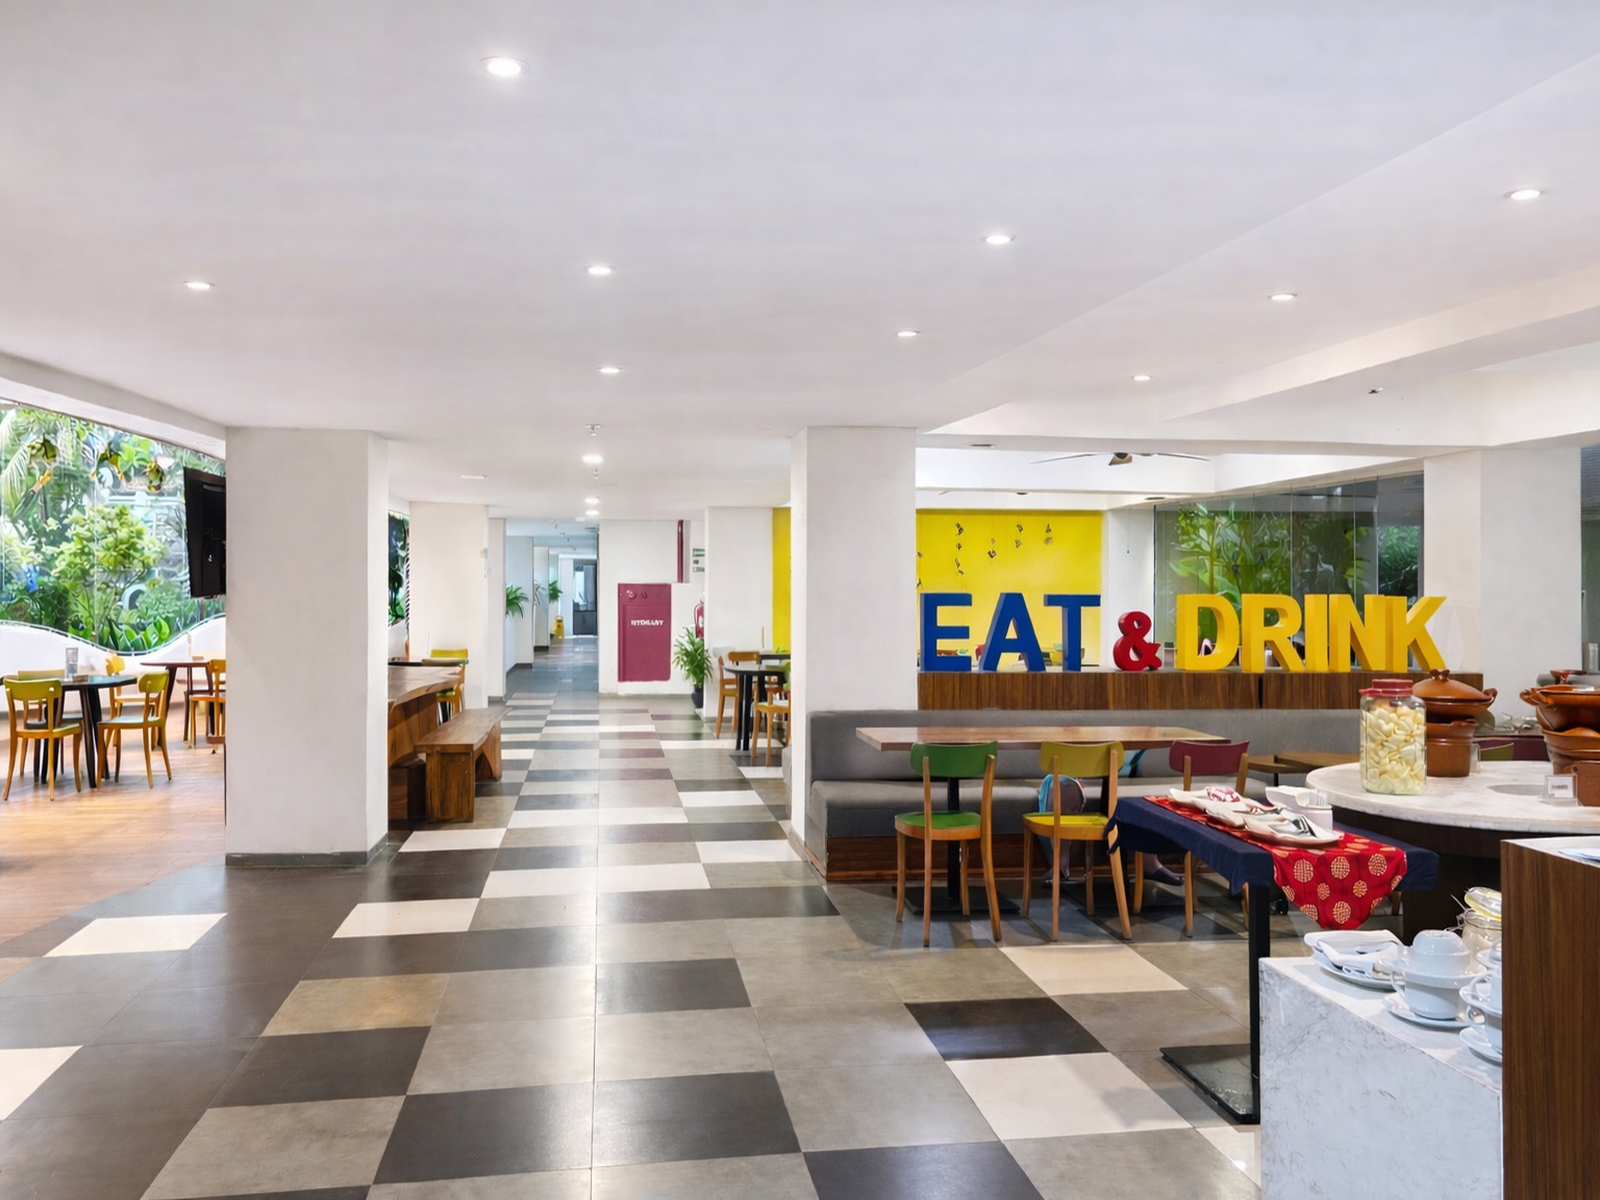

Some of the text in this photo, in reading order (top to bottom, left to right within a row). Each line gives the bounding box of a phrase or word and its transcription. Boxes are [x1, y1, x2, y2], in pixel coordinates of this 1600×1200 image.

[920, 593, 1447, 673] EAT & DRINK
